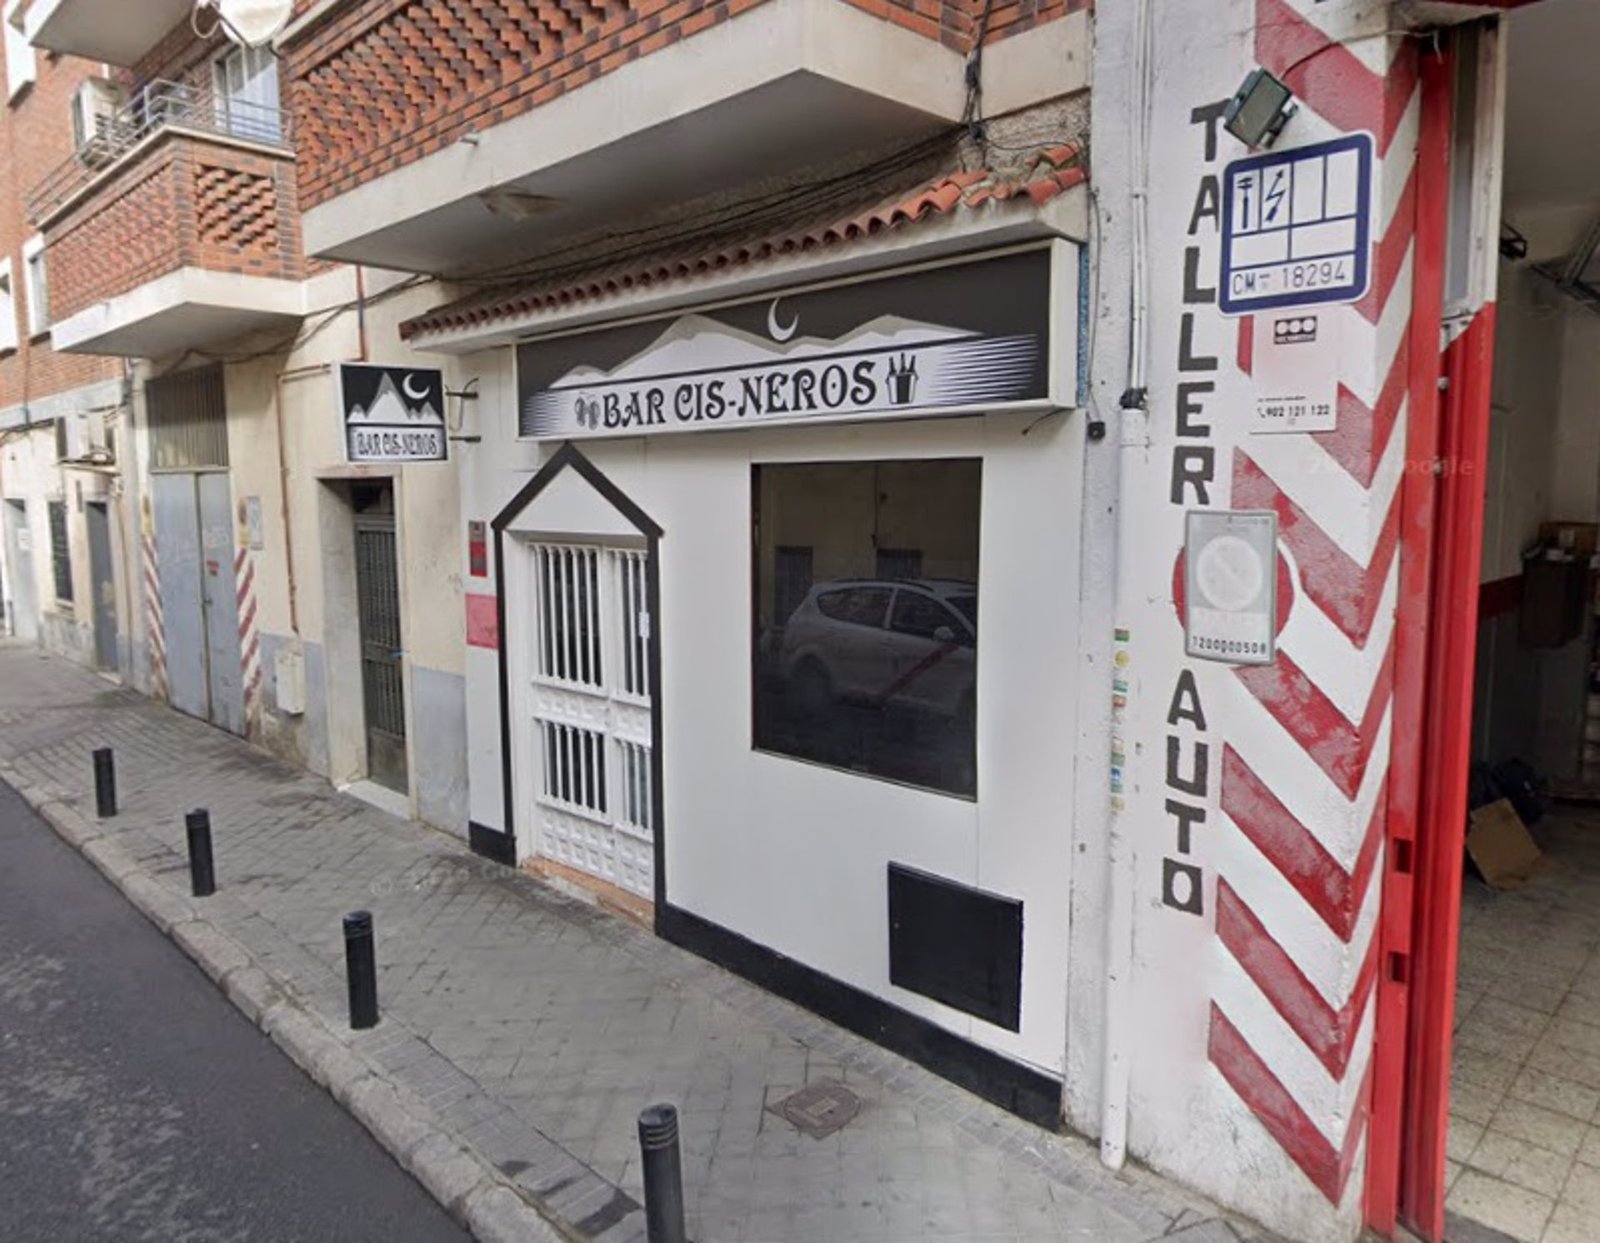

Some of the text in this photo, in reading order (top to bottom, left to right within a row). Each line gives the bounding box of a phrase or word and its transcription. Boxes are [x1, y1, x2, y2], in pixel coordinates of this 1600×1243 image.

[1170, 98, 1232, 505] TALLER
[1282, 260, 1346, 289] 18294
[601, 360, 878, 429] BAR CIS-NEROS
[357, 432, 381, 456] BAR
[1162, 668, 1208, 917] AUTO
